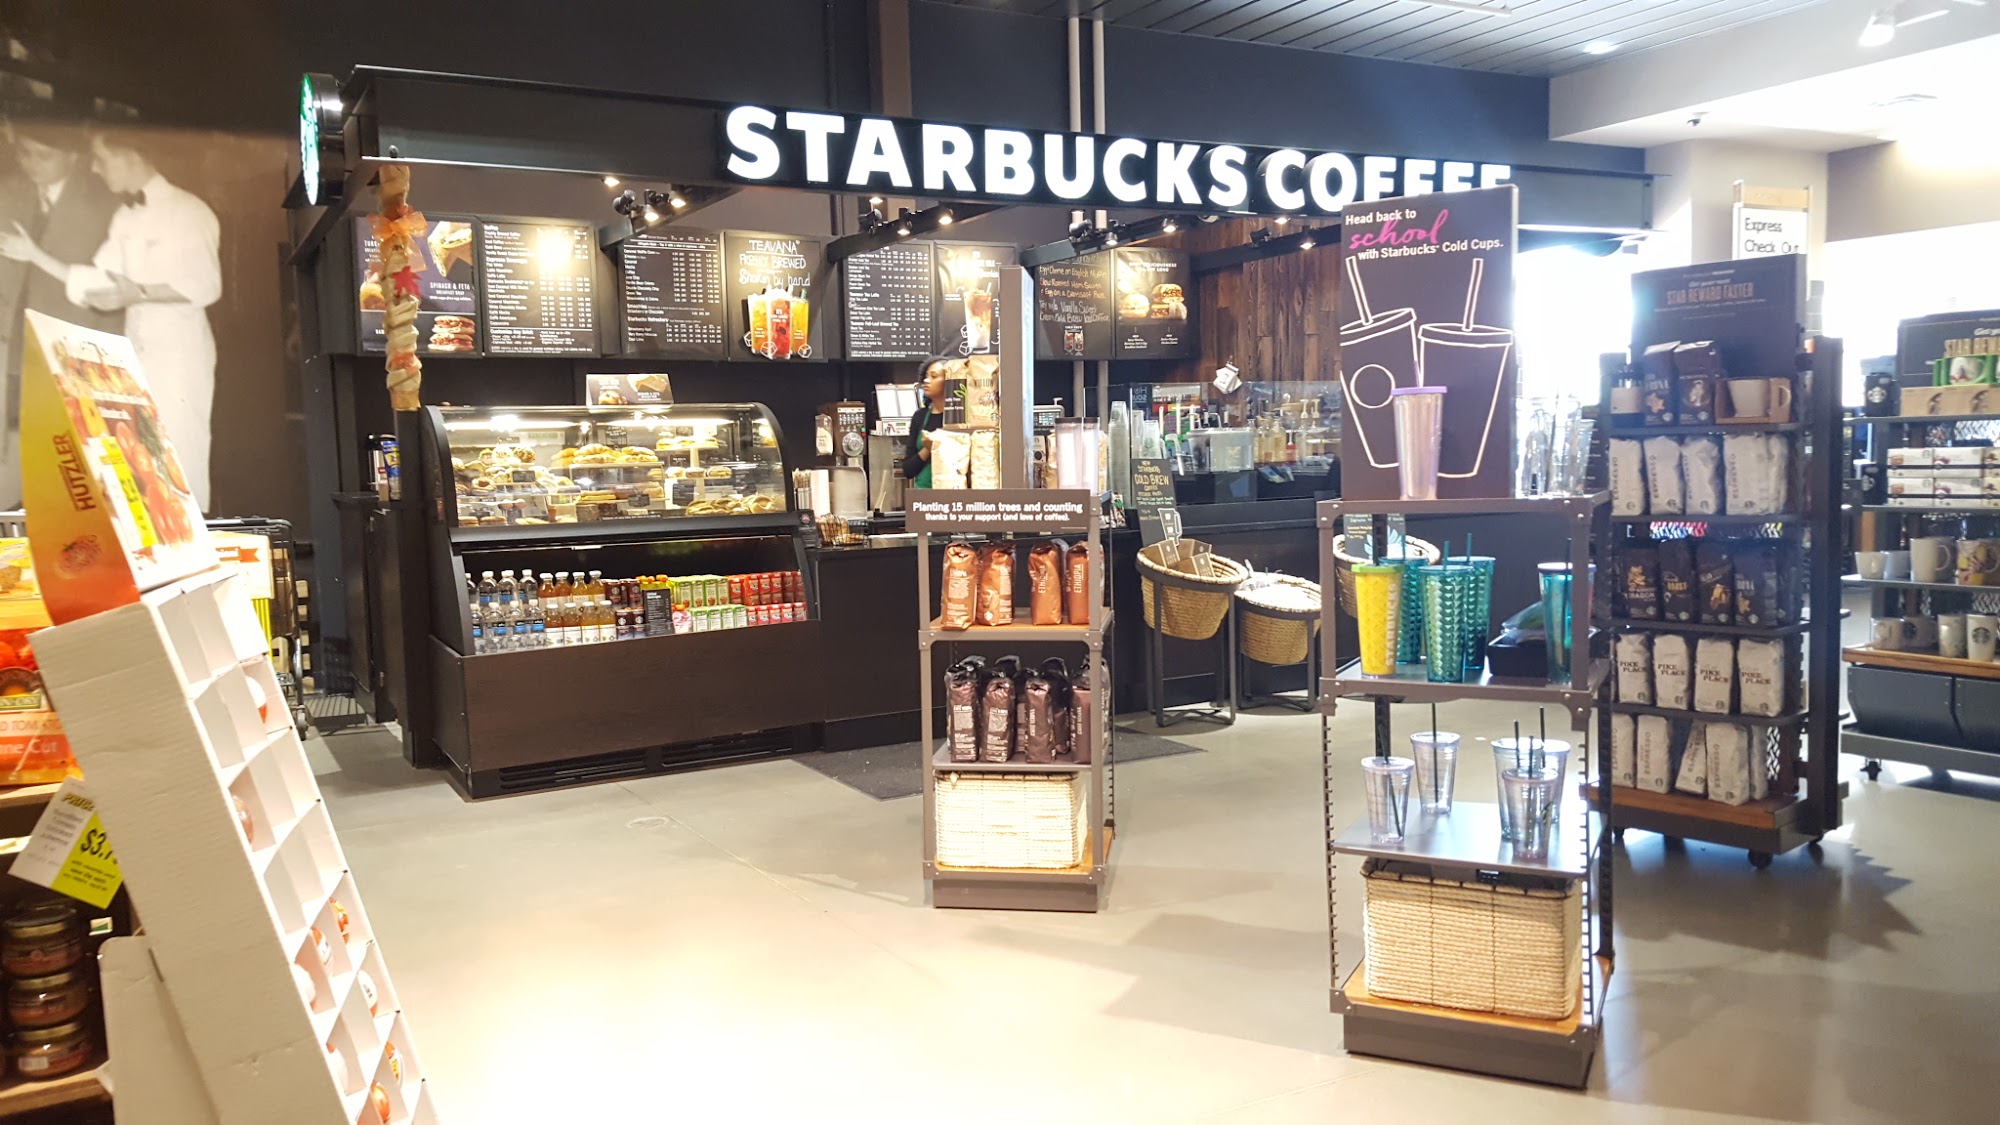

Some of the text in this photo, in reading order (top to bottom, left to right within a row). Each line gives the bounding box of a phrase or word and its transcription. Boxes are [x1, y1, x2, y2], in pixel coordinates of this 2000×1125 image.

[726, 105, 1249, 207] STARBUCKS
[1345, 209, 1416, 225] Head back to
[1745, 217, 1782, 234] Express
[1349, 209, 1448, 249] school
[1358, 249, 1379, 260] with
[1442, 240, 1468, 252] Cold
[1471, 238, 1504, 250] Cups.
[1745, 240, 1799, 253] Check Out
[772, 256, 806, 269] BREWED
[773, 274, 784, 289] by
[788, 272, 810, 286] hand
[1667, 283, 1754, 304] STAR REWARD FASTER
[1060, 300, 1078, 313] Vanilla
[53, 433, 97, 511] HUTZLER
[1134, 474, 1169, 486] COLD BREW
[1650, 455, 1659, 498] ESPRESSO
[912, 502, 1083, 513] Planting 15 million trees and counting
[925, 513, 1070, 523] thanks to your support (and love of coffee).
[1074, 564, 1082, 593] ETHIOPIA
[1386, 584, 1398, 666] STARBUCKS
[32, 739, 57, 752] Cut
